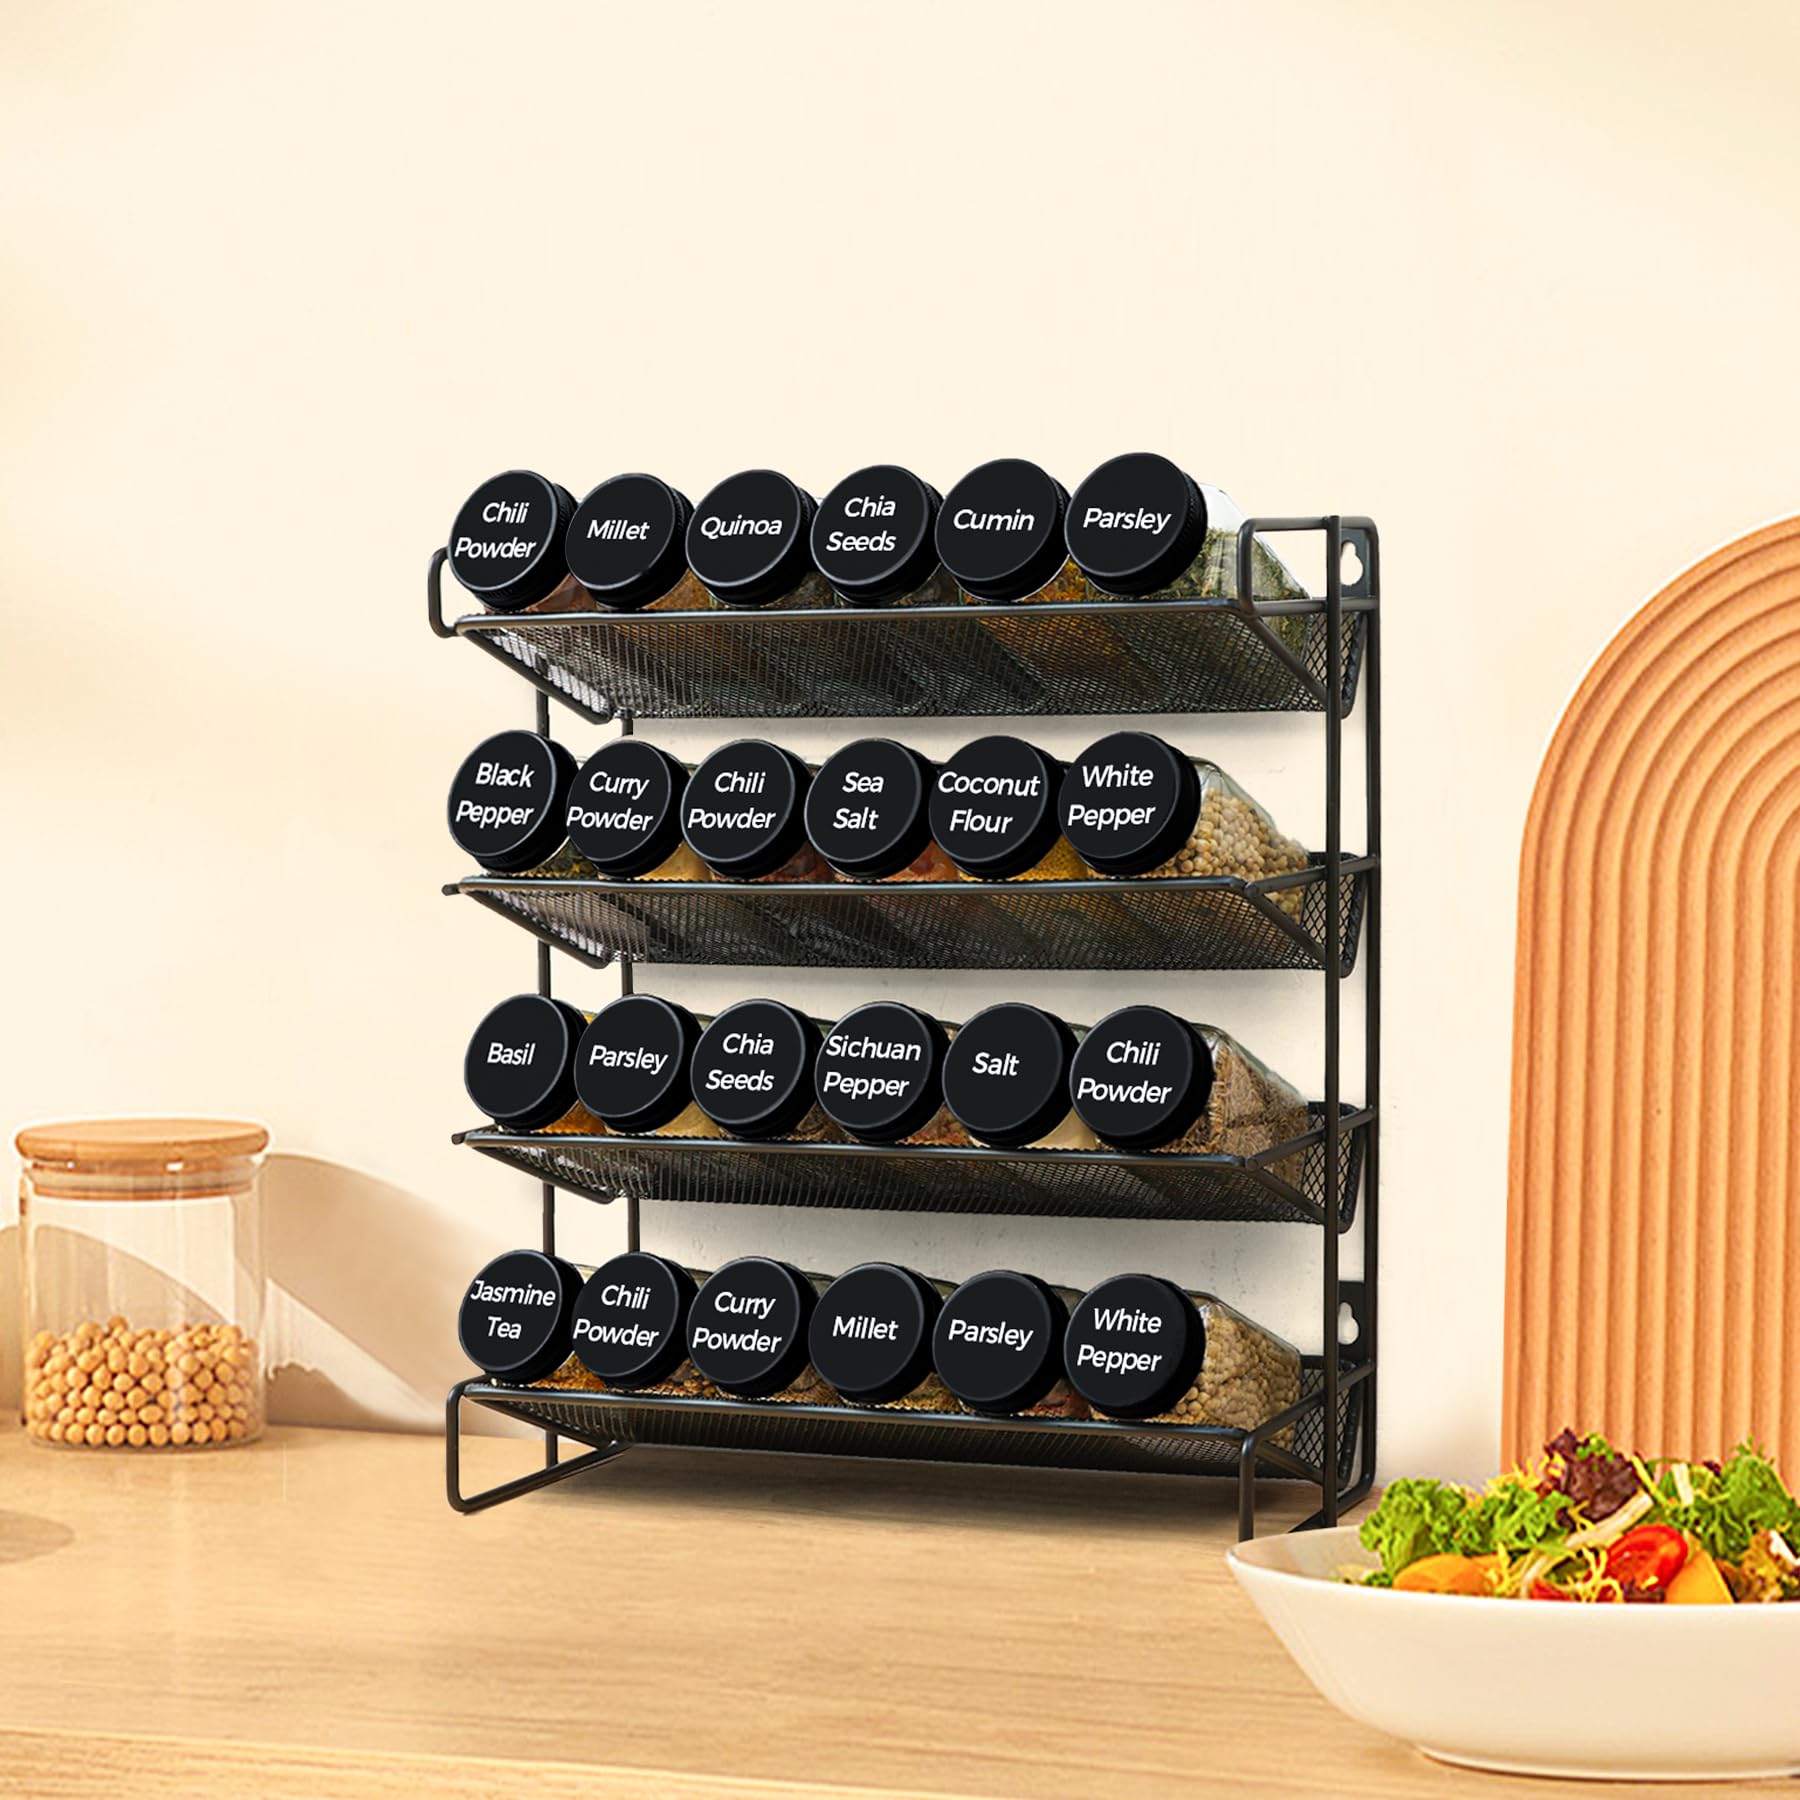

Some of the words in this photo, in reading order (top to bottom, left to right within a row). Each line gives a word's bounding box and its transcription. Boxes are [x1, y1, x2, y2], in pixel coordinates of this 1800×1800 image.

[482, 500, 530, 524] Chili
[844, 494, 896, 518] Chia
[586, 519, 651, 541] Millet
[700, 514, 783, 540] Quinoa
[953, 508, 1035, 531] Cumin
[1082, 507, 1172, 535] Parsley
[454, 536, 537, 559] Powder
[825, 530, 897, 552] Seeds
[475, 762, 535, 788] Black
[589, 771, 650, 801] Curry
[714, 770, 766, 794] Chili
[841, 771, 885, 793] Sea
[937, 771, 1041, 797] Coconut
[1082, 763, 1154, 788] White
[455, 799, 535, 829] Pepper
[565, 805, 654, 832] Powder
[687, 807, 777, 829] Powder
[832, 806, 880, 831] Salt
[949, 808, 1014, 834] Flour
[1067, 804, 1157, 831] Pepper
[486, 1042, 536, 1066] Basil
[722, 1032, 775, 1055] Chia
[825, 1034, 922, 1061] Sichuan
[1106, 1039, 1161, 1066] Chili
[589, 1044, 669, 1076] Parsley
[971, 1051, 1020, 1077] Salt
[705, 1069, 775, 1092] Seeds
[823, 1071, 910, 1100] Pepper
[1076, 1077, 1173, 1105] Powder
[470, 1279, 556, 1307] Jasmine
[601, 1284, 652, 1310] Chili
[714, 1291, 777, 1320] Curry
[487, 1315, 522, 1340] Tea
[572, 1318, 660, 1348] Powder
[832, 1315, 899, 1341] Millet
[1094, 1307, 1162, 1334] White
[692, 1326, 783, 1353] Powder
[948, 1318, 1034, 1352] Parsley
[1076, 1343, 1163, 1375] Pepper
